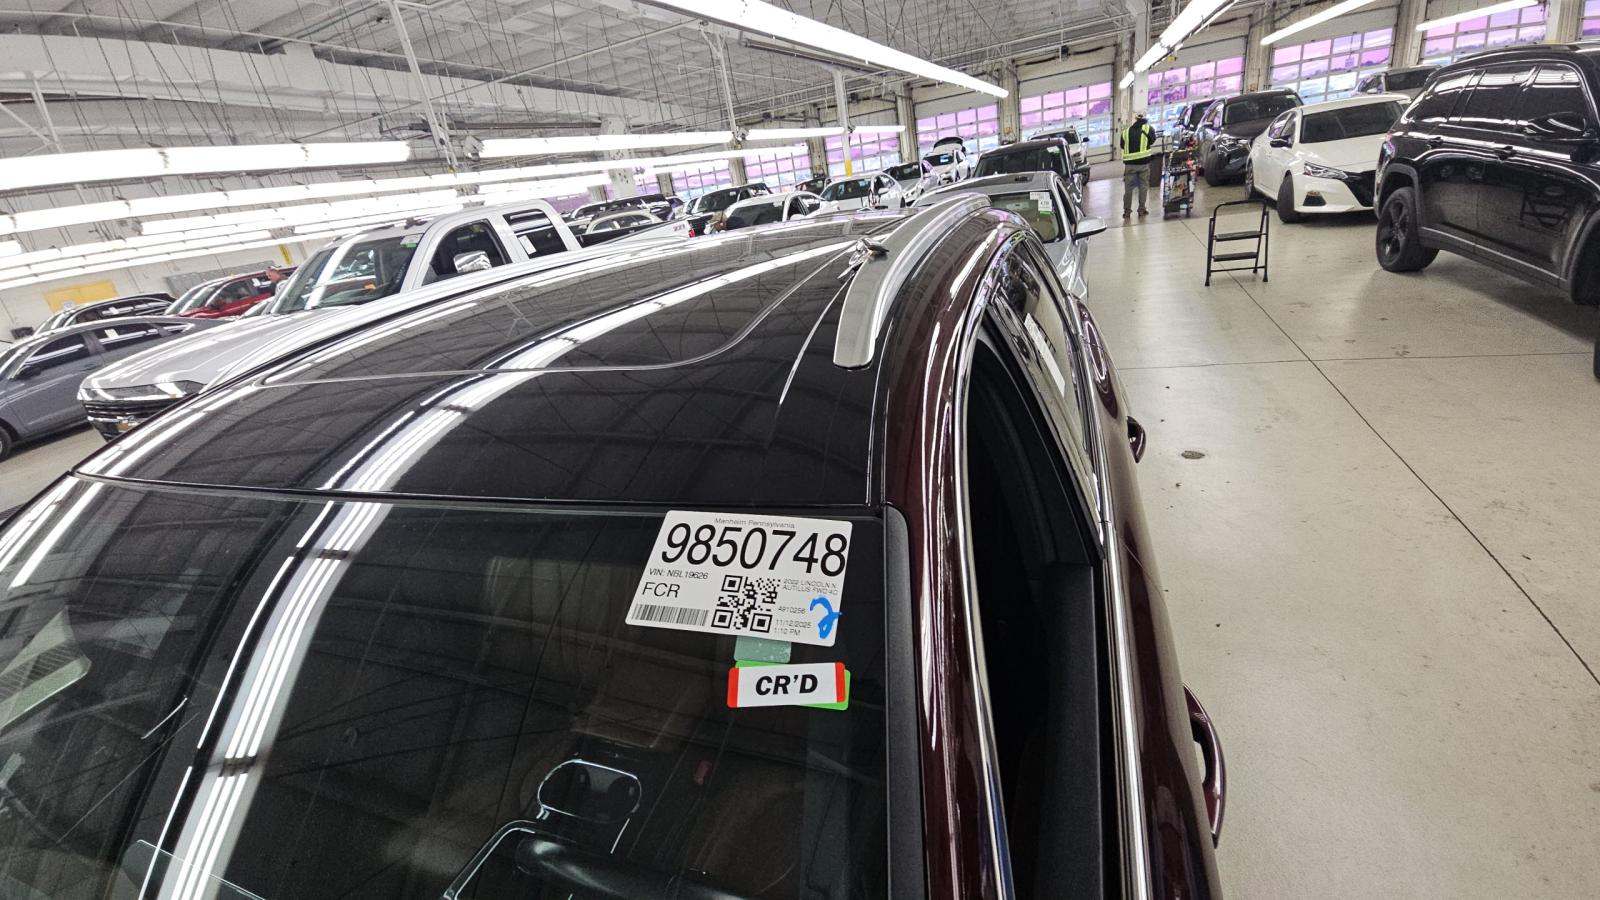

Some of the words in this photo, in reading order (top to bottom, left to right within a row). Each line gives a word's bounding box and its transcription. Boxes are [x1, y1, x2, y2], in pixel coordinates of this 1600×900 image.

[714, 517, 747, 525] Manheim
[748, 519, 796, 529] Pennsylvania
[661, 522, 848, 577] 9850748
[649, 568, 665, 576] VIN:
[667, 569, 709, 580] NBL19626
[642, 581, 681, 598] FCR
[801, 580, 831, 588] LINCOLN
[775, 618, 812, 628] 11/12/2025
[789, 628, 801, 636] PM
[755, 674, 818, 696] CR'D
